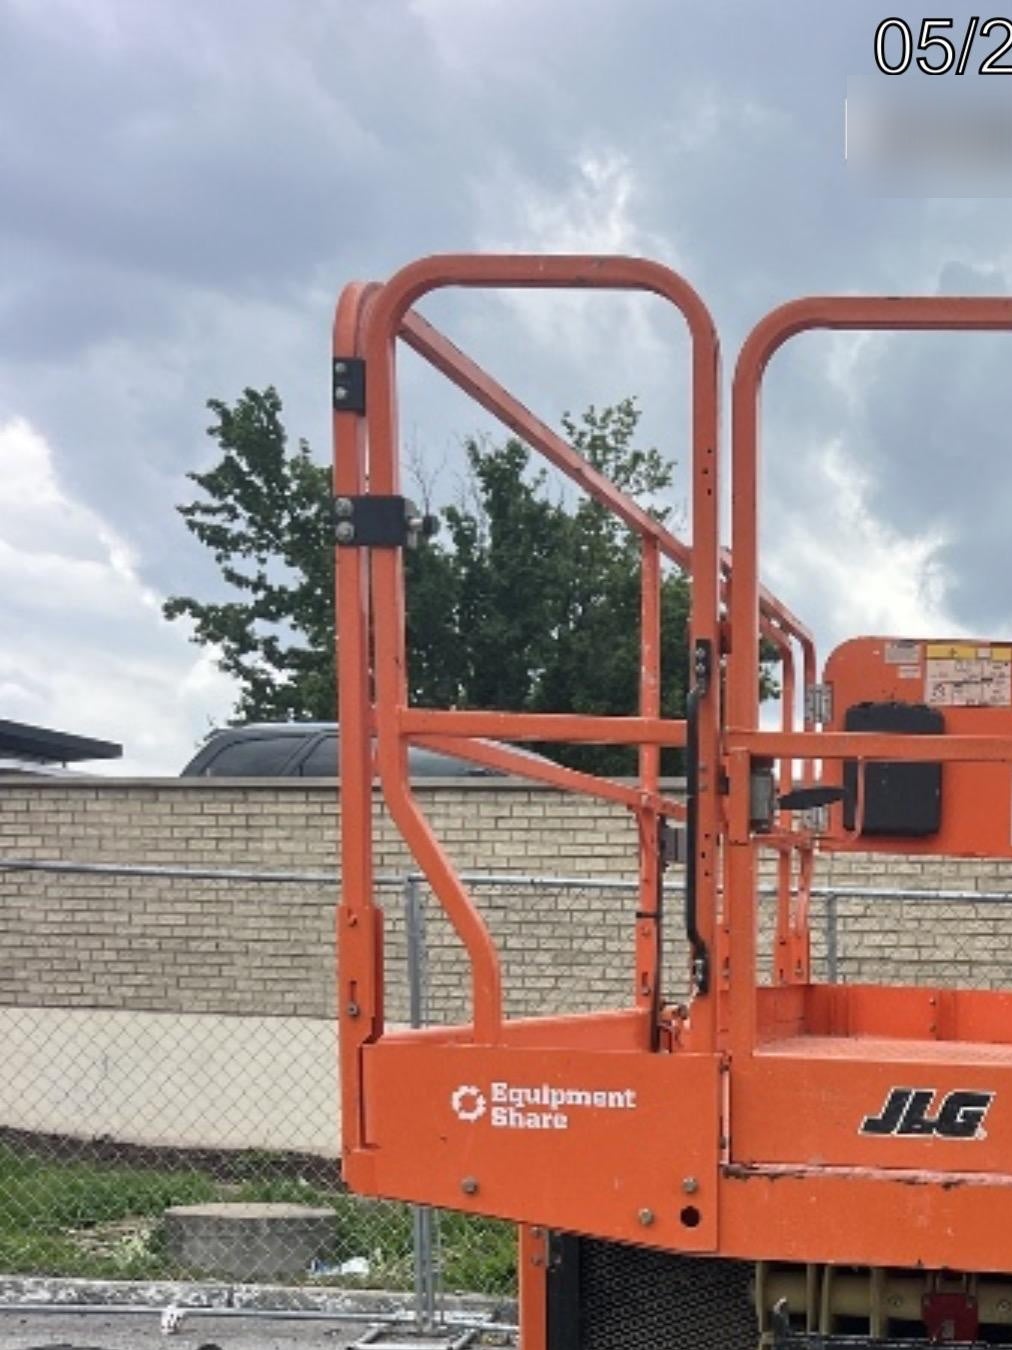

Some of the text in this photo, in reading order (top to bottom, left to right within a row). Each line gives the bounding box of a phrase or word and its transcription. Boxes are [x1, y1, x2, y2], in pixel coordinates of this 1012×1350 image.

[490, 1082, 636, 1110] Equipment
[490, 1106, 568, 1129] Share
[858, 1086, 996, 1141] JLG
